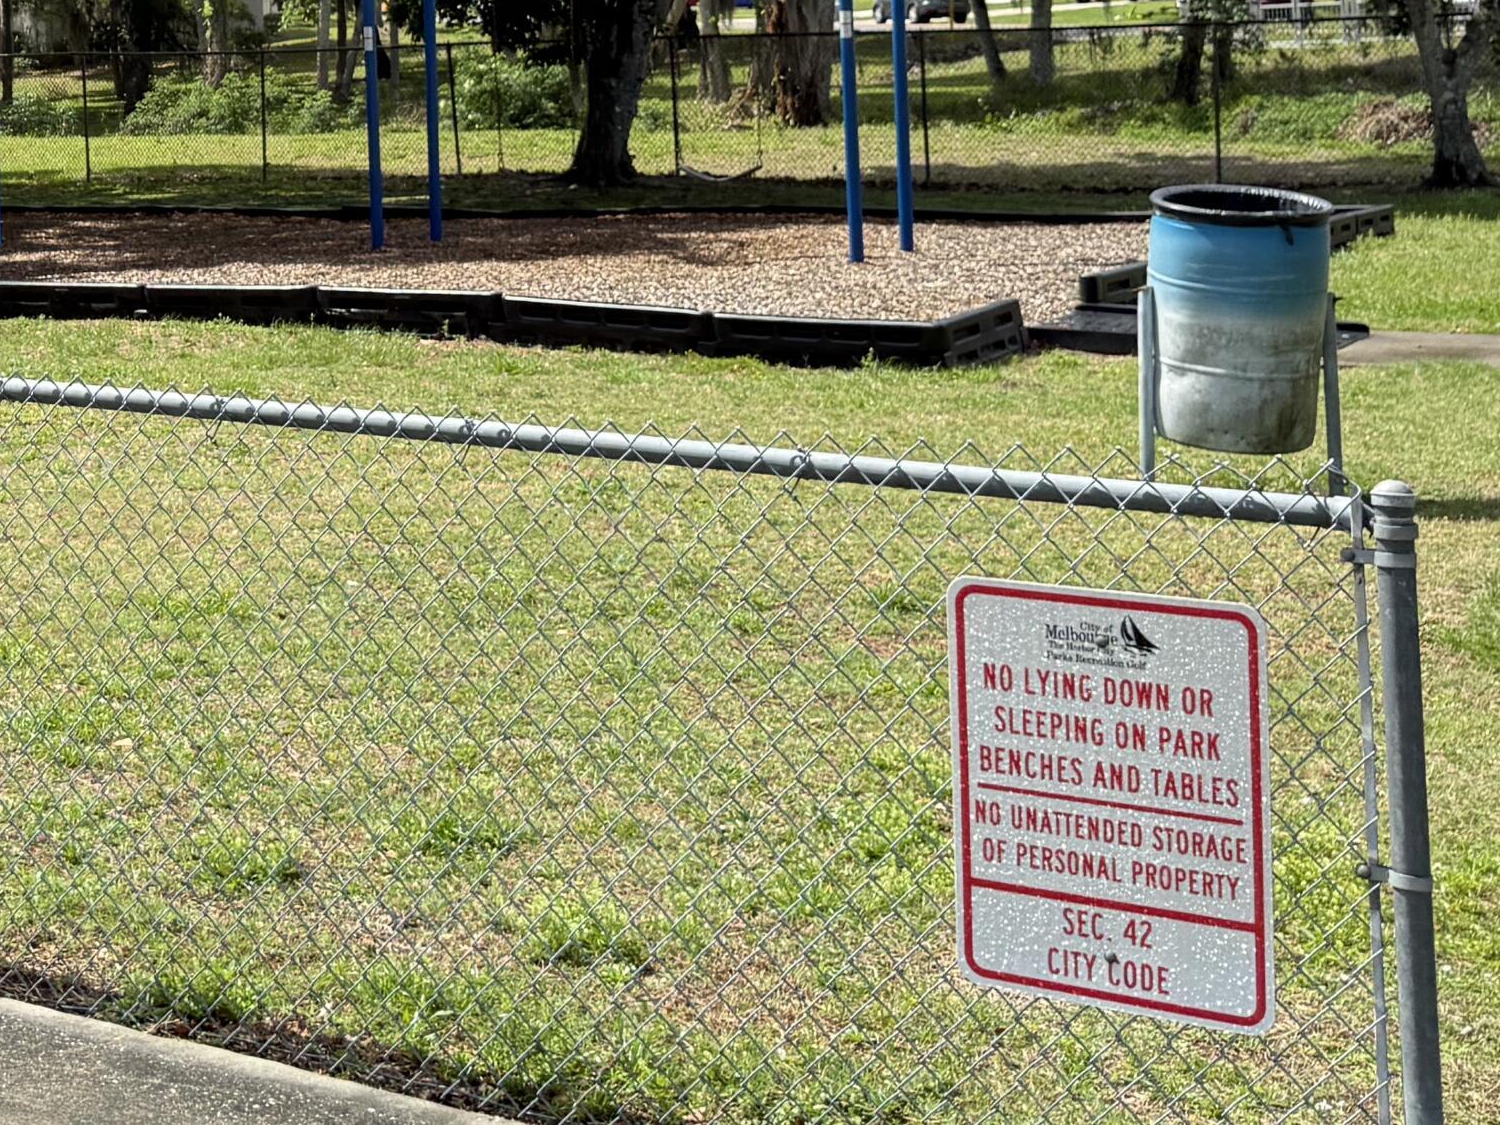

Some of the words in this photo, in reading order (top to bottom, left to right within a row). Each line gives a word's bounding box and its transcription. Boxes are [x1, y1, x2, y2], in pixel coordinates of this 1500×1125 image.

[1080, 622, 1101, 632] City
[1103, 624, 1113, 633] of
[1046, 650, 1073, 662] Parks
[1075, 654, 1124, 668] Recreation
[1126, 660, 1148, 670] Golf
[983, 663, 1014, 692] NO
[1023, 667, 1093, 703] LYING
[1103, 677, 1170, 712] DOWN
[1181, 686, 1215, 717] OR
[994, 704, 1105, 747] SLEEPING
[1114, 721, 1148, 752] ON
[1158, 726, 1221, 762] PARK
[979, 745, 1084, 786] BENCHES
[1092, 762, 1142, 795] AND
[1151, 768, 1240, 808] TABLES
[974, 799, 1002, 828] NO
[1011, 806, 1144, 849] UNATTENDED
[1152, 826, 1248, 864] STORAGE
[982, 838, 1007, 864] OF
[1016, 842, 1123, 884] PERSONAL
[1131, 860, 1240, 901] PROPERTY
[1062, 906, 1112, 942] SEC.
[1123, 919, 1154, 950] 42
[1047, 946, 1097, 981] CITY
[1106, 959, 1170, 996] CODE
